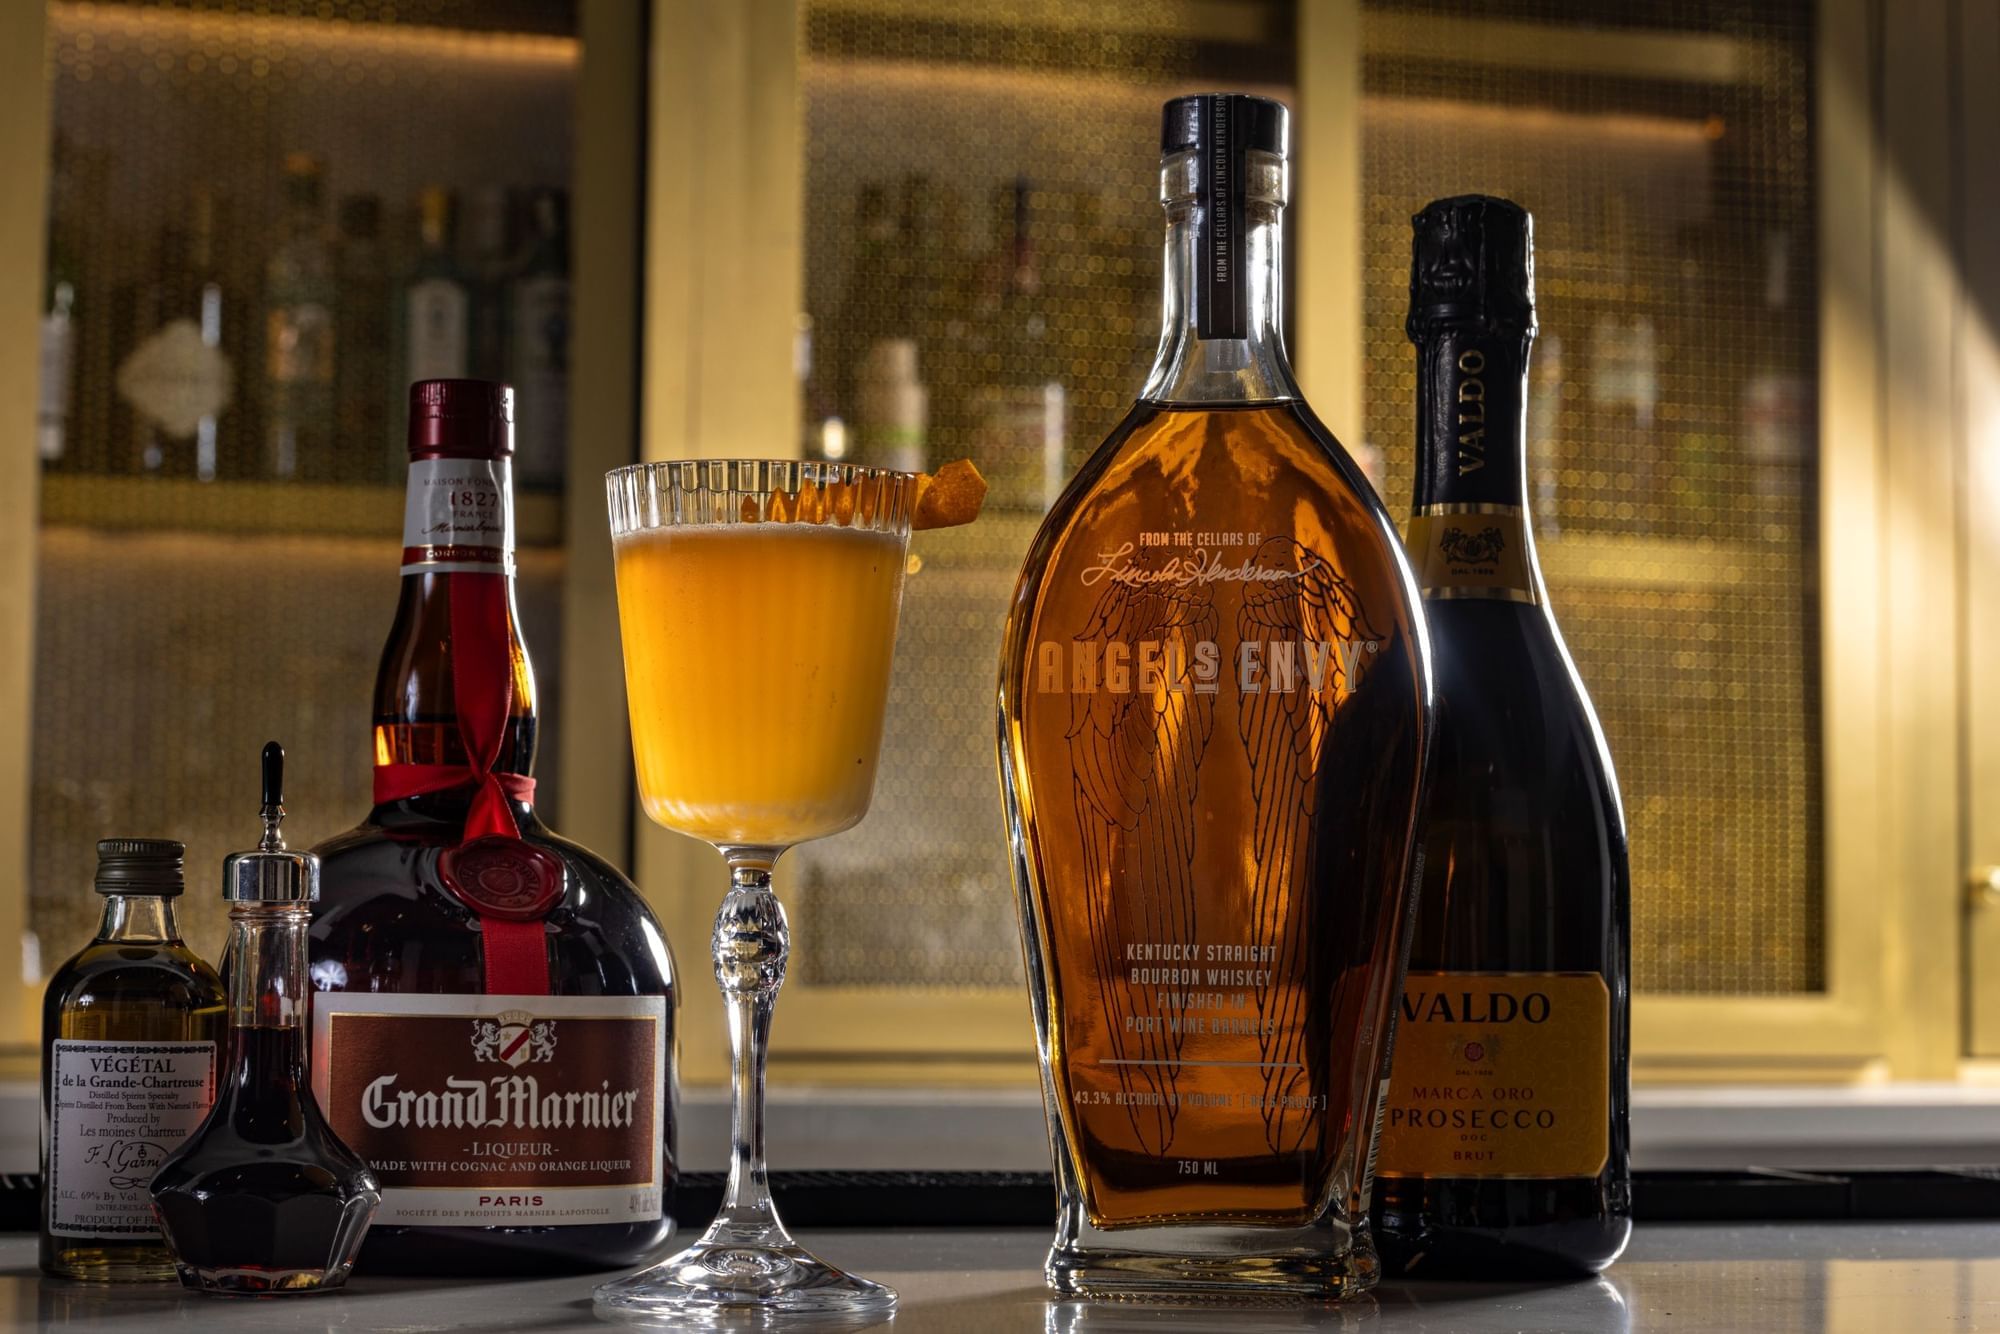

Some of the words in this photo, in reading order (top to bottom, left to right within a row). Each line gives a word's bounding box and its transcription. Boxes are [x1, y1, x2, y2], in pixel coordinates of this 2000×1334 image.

[1215, 148, 1227, 184] LINCOLN
[1216, 186, 1227, 198] OF
[1216, 200, 1227, 238] CELLARS
[1216, 240, 1227, 256] THE
[1216, 259, 1227, 282] FROM
[1458, 350, 1485, 477] VALDO
[451, 491, 499, 507] 1827
[453, 511, 493, 519] FRANCE
[1139, 532, 1170, 547] FROM
[1174, 532, 1193, 547] THE
[1197, 532, 1244, 547] CELLARS
[1248, 532, 1262, 547] OF
[1127, 944, 1200, 961] KENTUCKY
[1206, 945, 1277, 963] STRAIGHT
[1131, 968, 1200, 985] BOURBON
[1206, 969, 1272, 987] WHISKEY
[1157, 992, 1224, 1010] FINISHED
[1232, 993, 1246, 1010] IN
[1401, 992, 1551, 1024] VALDO
[1126, 1016, 1163, 1033] PORT
[1169, 1017, 1205, 1034] WINE
[1212, 1018, 1276, 1036] BARRELS
[91, 1055, 176, 1073] VÉGÉTAL
[62, 1074, 75, 1087] de
[76, 1074, 87, 1087] la
[89, 1075, 205, 1089] Grande-Chartreuse
[89, 1090, 120, 1100] Distilled
[361, 1072, 488, 1130] Grand
[485, 1074, 639, 1130] Marnier
[1074, 1091, 1111, 1105] 43.3%
[1115, 1092, 1166, 1106] ALCOHOL
[1281, 1095, 1318, 1109] PROOF
[1412, 1087, 1483, 1101] MARCA
[1492, 1087, 1534, 1101] ORO
[76, 1101, 103, 1110] Distilled
[105, 1102, 125, 1110] From
[107, 1113, 149, 1124] Produced
[150, 1113, 161, 1126] by
[1391, 1109, 1556, 1129] PROSECCO
[80, 1125, 97, 1137] Les
[98, 1126, 136, 1138] moines
[138, 1125, 187, 1138] Chartreux
[1460, 1134, 1488, 1142] DOC
[1453, 1151, 1497, 1161] BRUT
[370, 1160, 408, 1172] MADE
[410, 1160, 447, 1172] WITH
[450, 1160, 506, 1173] COGNAC
[508, 1161, 537, 1172] AND
[540, 1160, 589, 1173] ORANGE
[590, 1159, 632, 1174] LIQUEUR
[1177, 1161, 1199, 1175] 750
[1203, 1161, 1219, 1175] ML
[104, 1191, 115, 1202] By
[479, 1195, 545, 1207] PARIS
[75, 1215, 123, 1225] PRODUCT
[125, 1215, 143, 1225] OF
[441, 1209, 460, 1217] DES
[464, 1209, 512, 1217] PRODUITS
